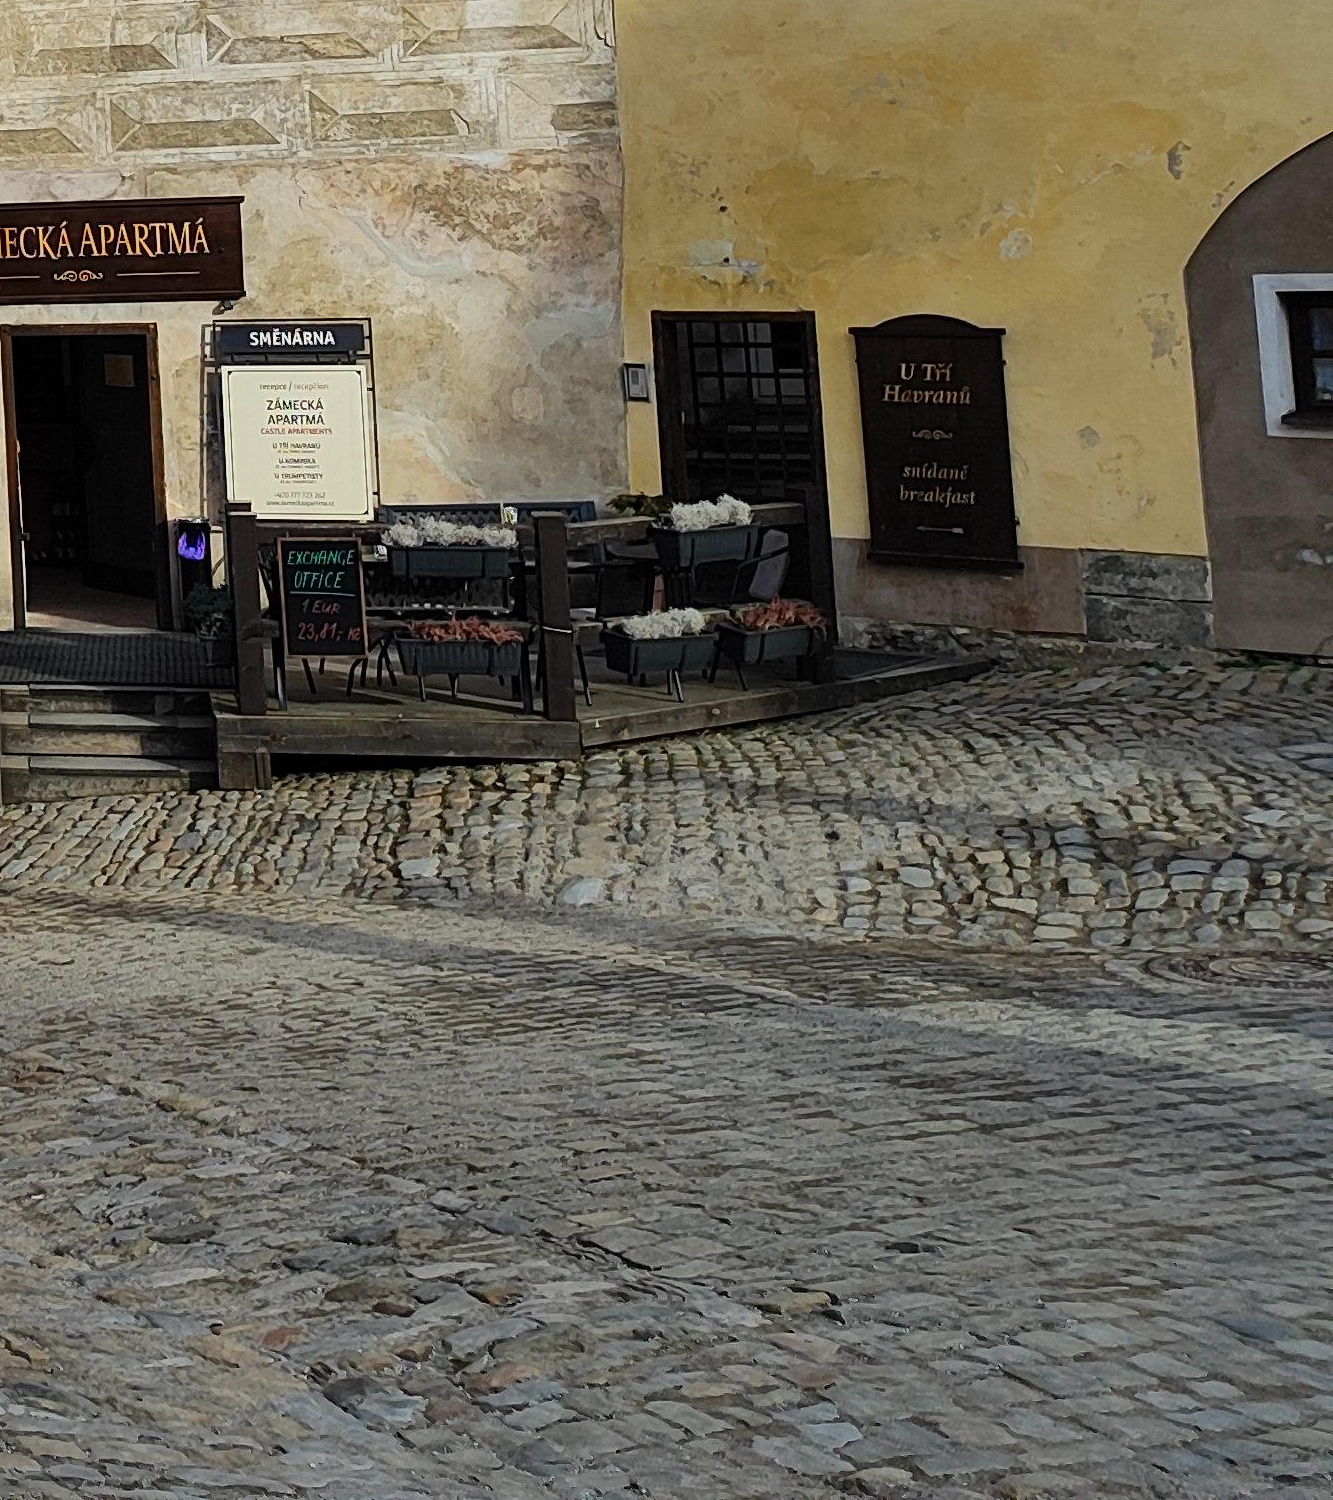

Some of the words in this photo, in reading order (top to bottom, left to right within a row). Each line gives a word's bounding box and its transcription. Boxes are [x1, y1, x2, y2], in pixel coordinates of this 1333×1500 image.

[78, 217, 211, 258] APARTMÁ
[249, 328, 336, 346] SMĚNÁRNA
[900, 363, 915, 380] U
[921, 362, 953, 382] Tří
[882, 384, 972, 404] Havranů
[266, 397, 324, 411] ZÁMECKÁ
[267, 412, 325, 426] APARTMÁ
[260, 427, 286, 435] CASTLE
[287, 426, 333, 435] APARTMENTS
[902, 462, 969, 480] snídaně
[899, 484, 976, 508] breakfast
[287, 549, 356, 566] EXCHANGE
[294, 570, 345, 589] OFFICE
[302, 598, 310, 614] 1
[312, 599, 342, 615] EUR
